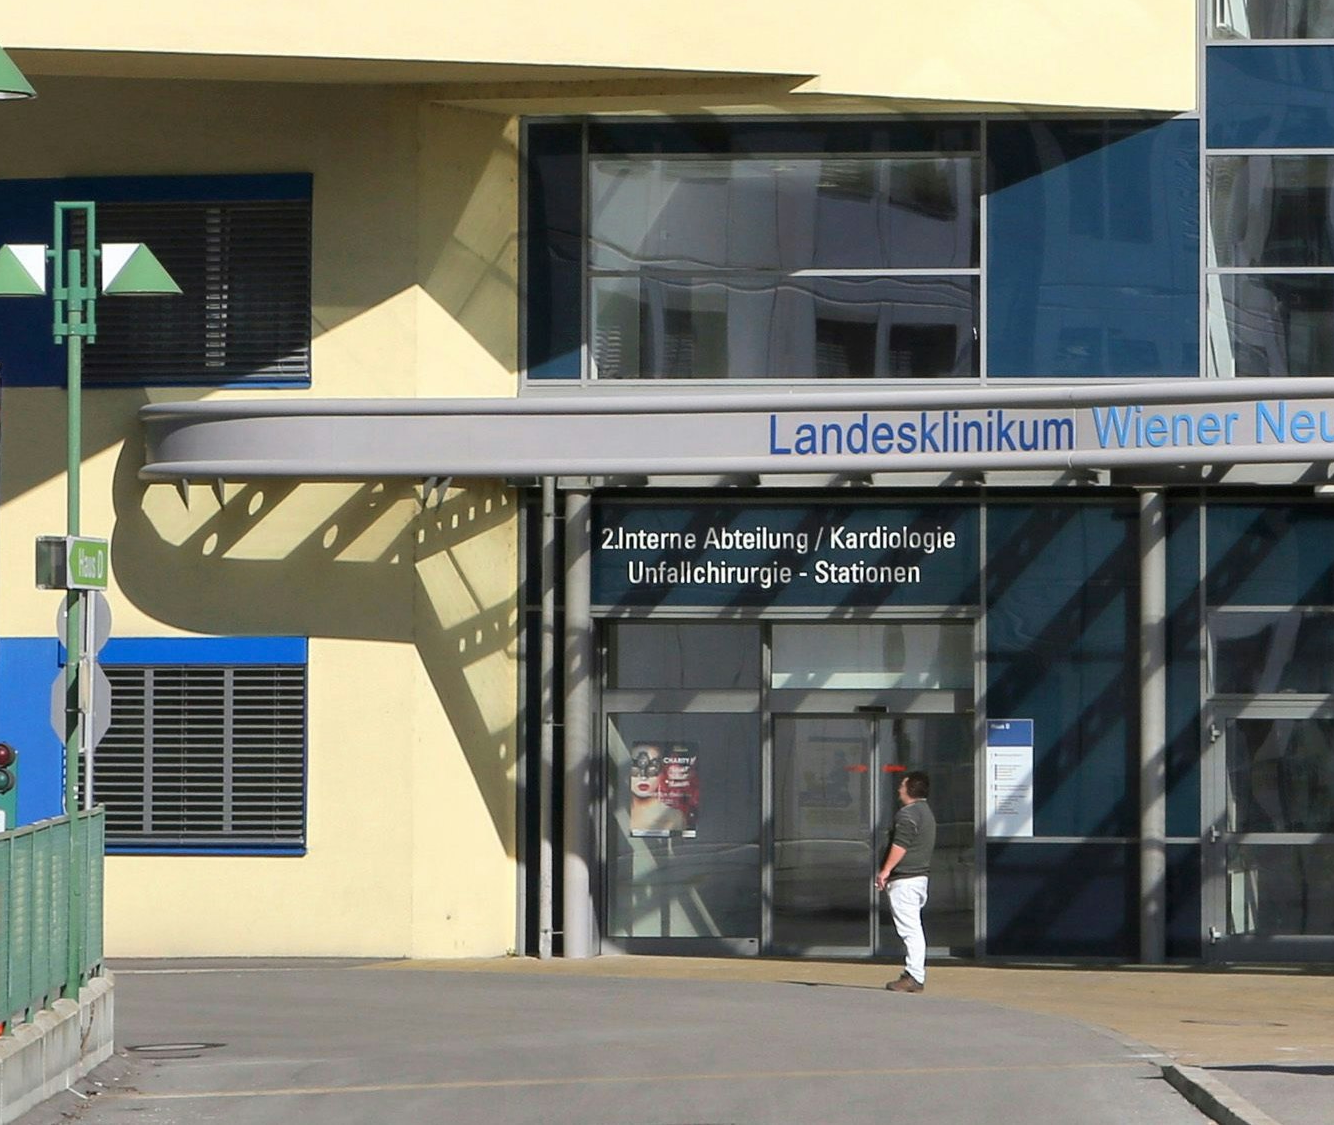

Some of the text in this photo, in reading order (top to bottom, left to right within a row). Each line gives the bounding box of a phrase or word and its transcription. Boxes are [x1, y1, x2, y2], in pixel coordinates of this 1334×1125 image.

[768, 410, 1075, 456] Landesklinikum
[1092, 405, 1239, 450] Wiener
[704, 526, 809, 554] Abteilung
[830, 525, 956, 554] Kardiologie
[627, 560, 792, 589] Unfallchirurgie
[815, 560, 921, 584] Stationen
